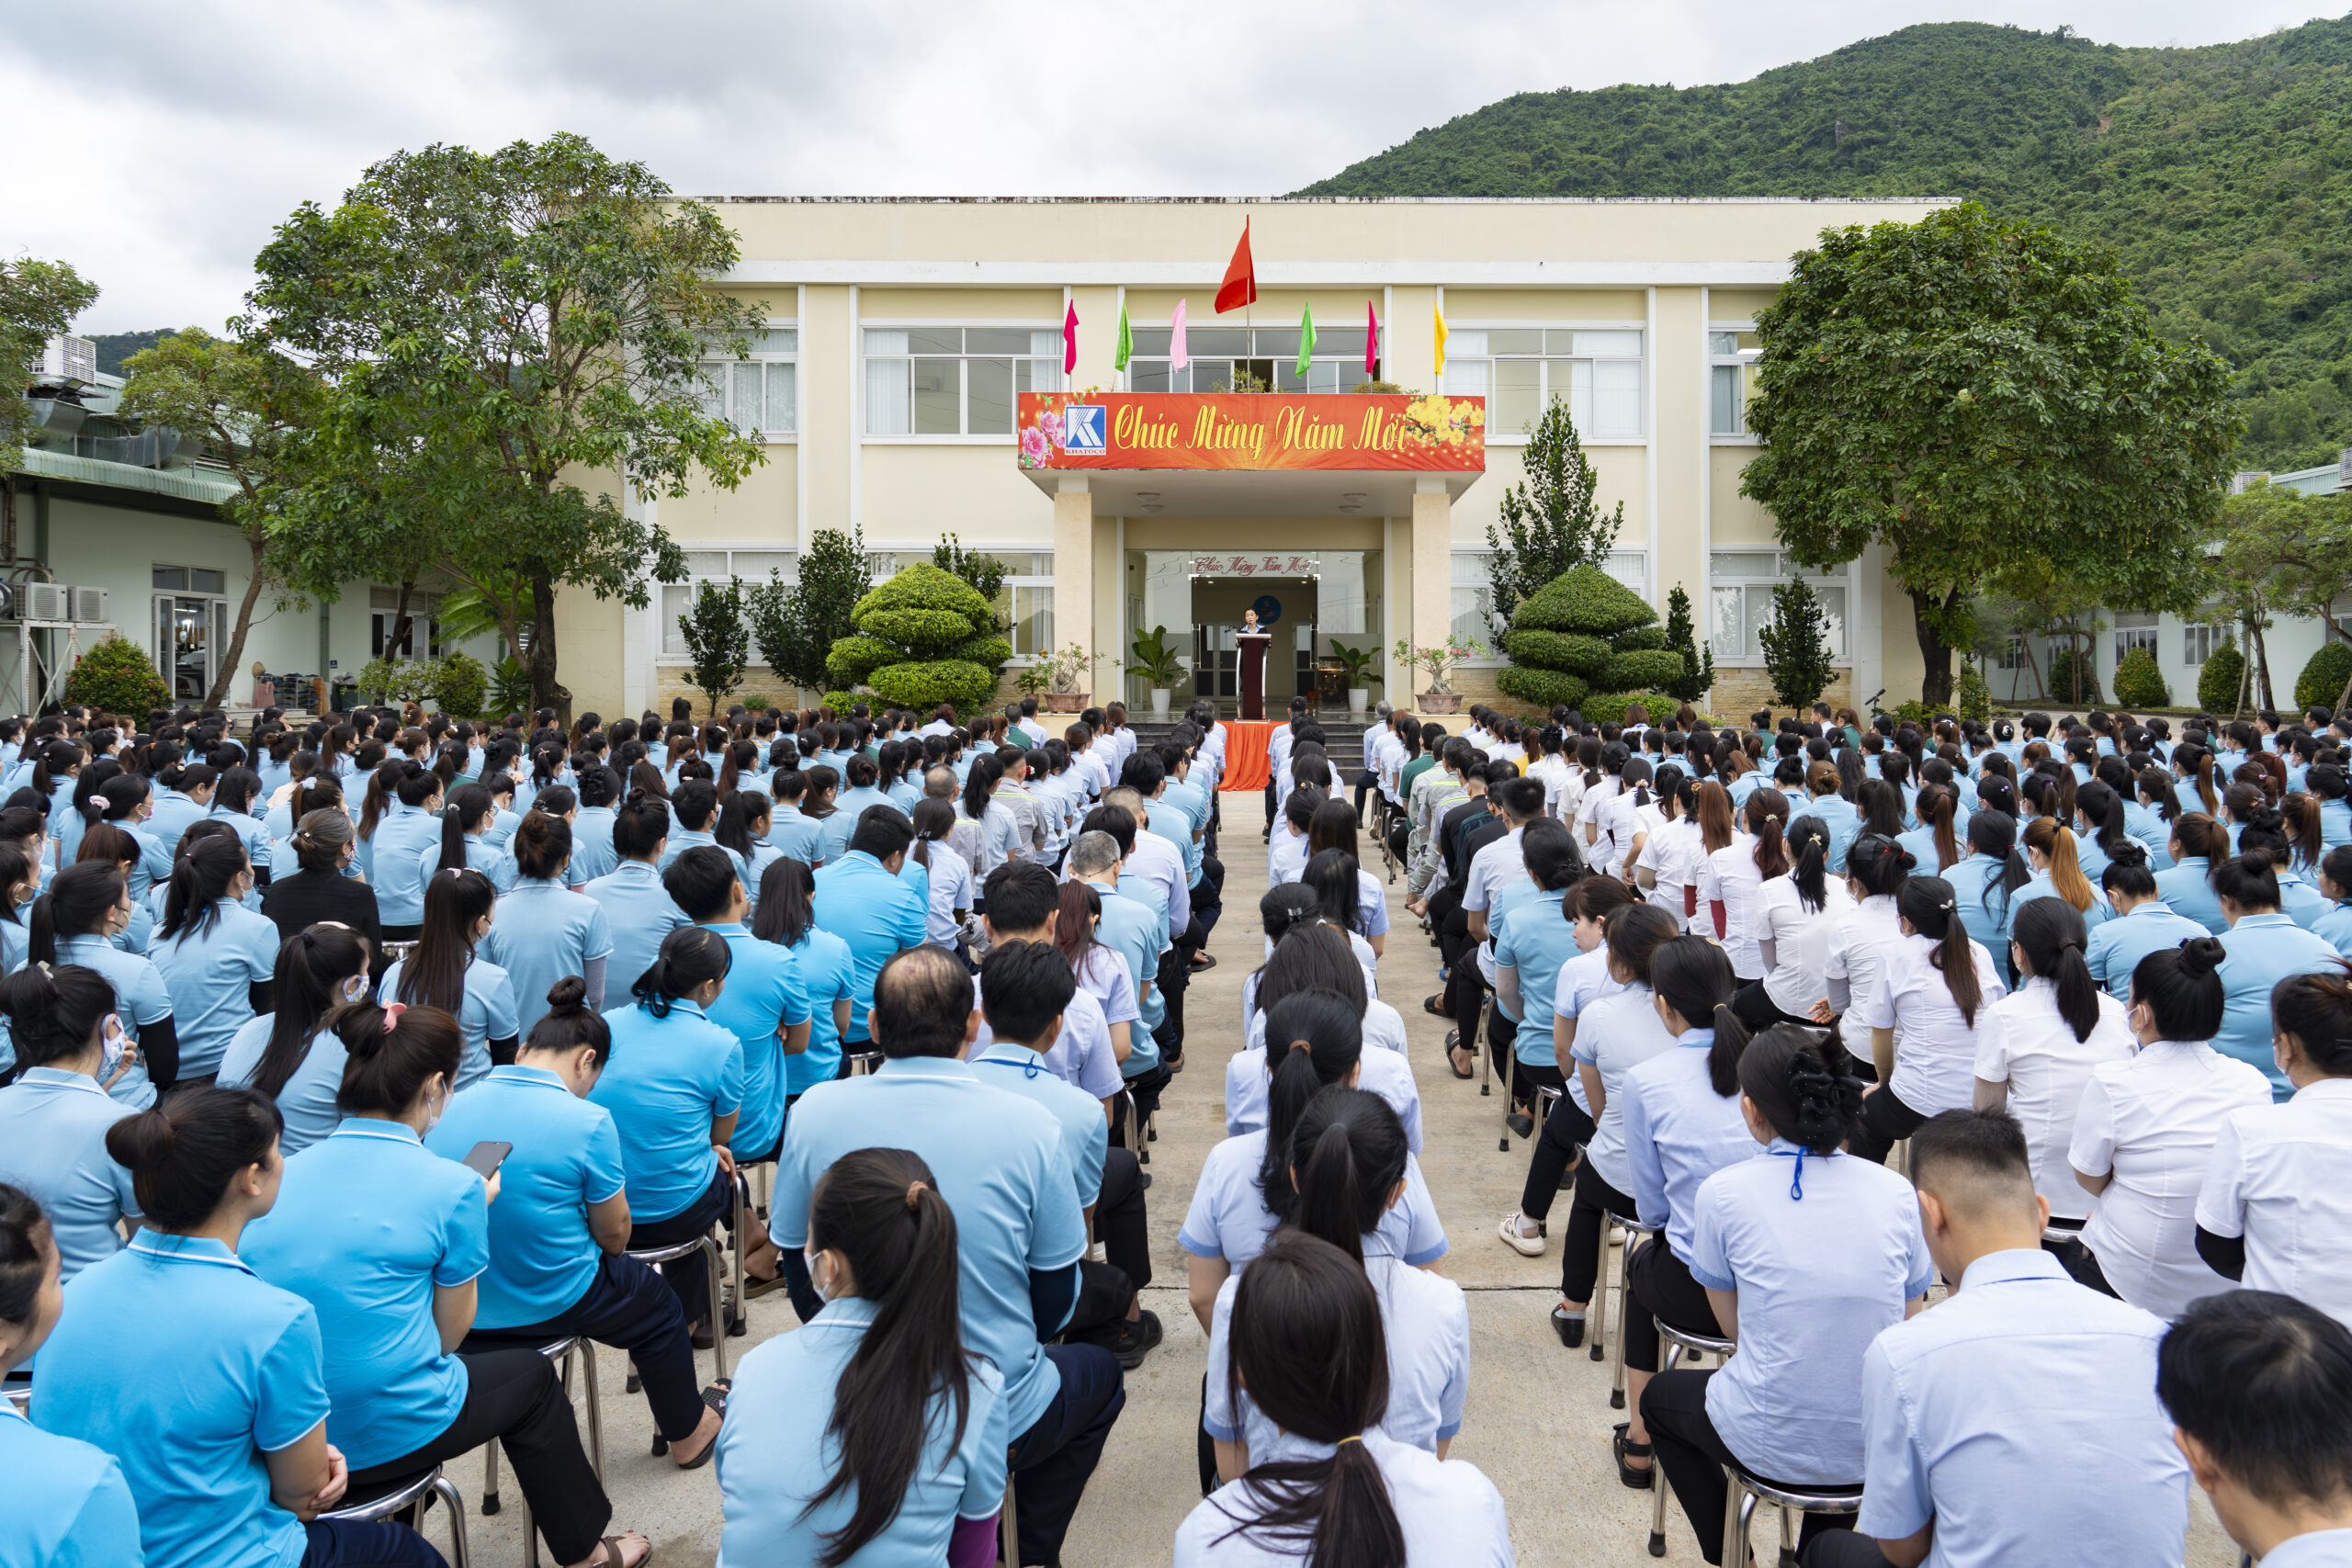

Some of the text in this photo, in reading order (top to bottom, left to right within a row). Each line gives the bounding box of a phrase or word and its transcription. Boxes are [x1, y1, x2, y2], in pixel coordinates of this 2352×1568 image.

[1114, 403, 1408, 461] Chúc Mừng Năm Mới
[1195, 556, 1224, 574] Chúc
